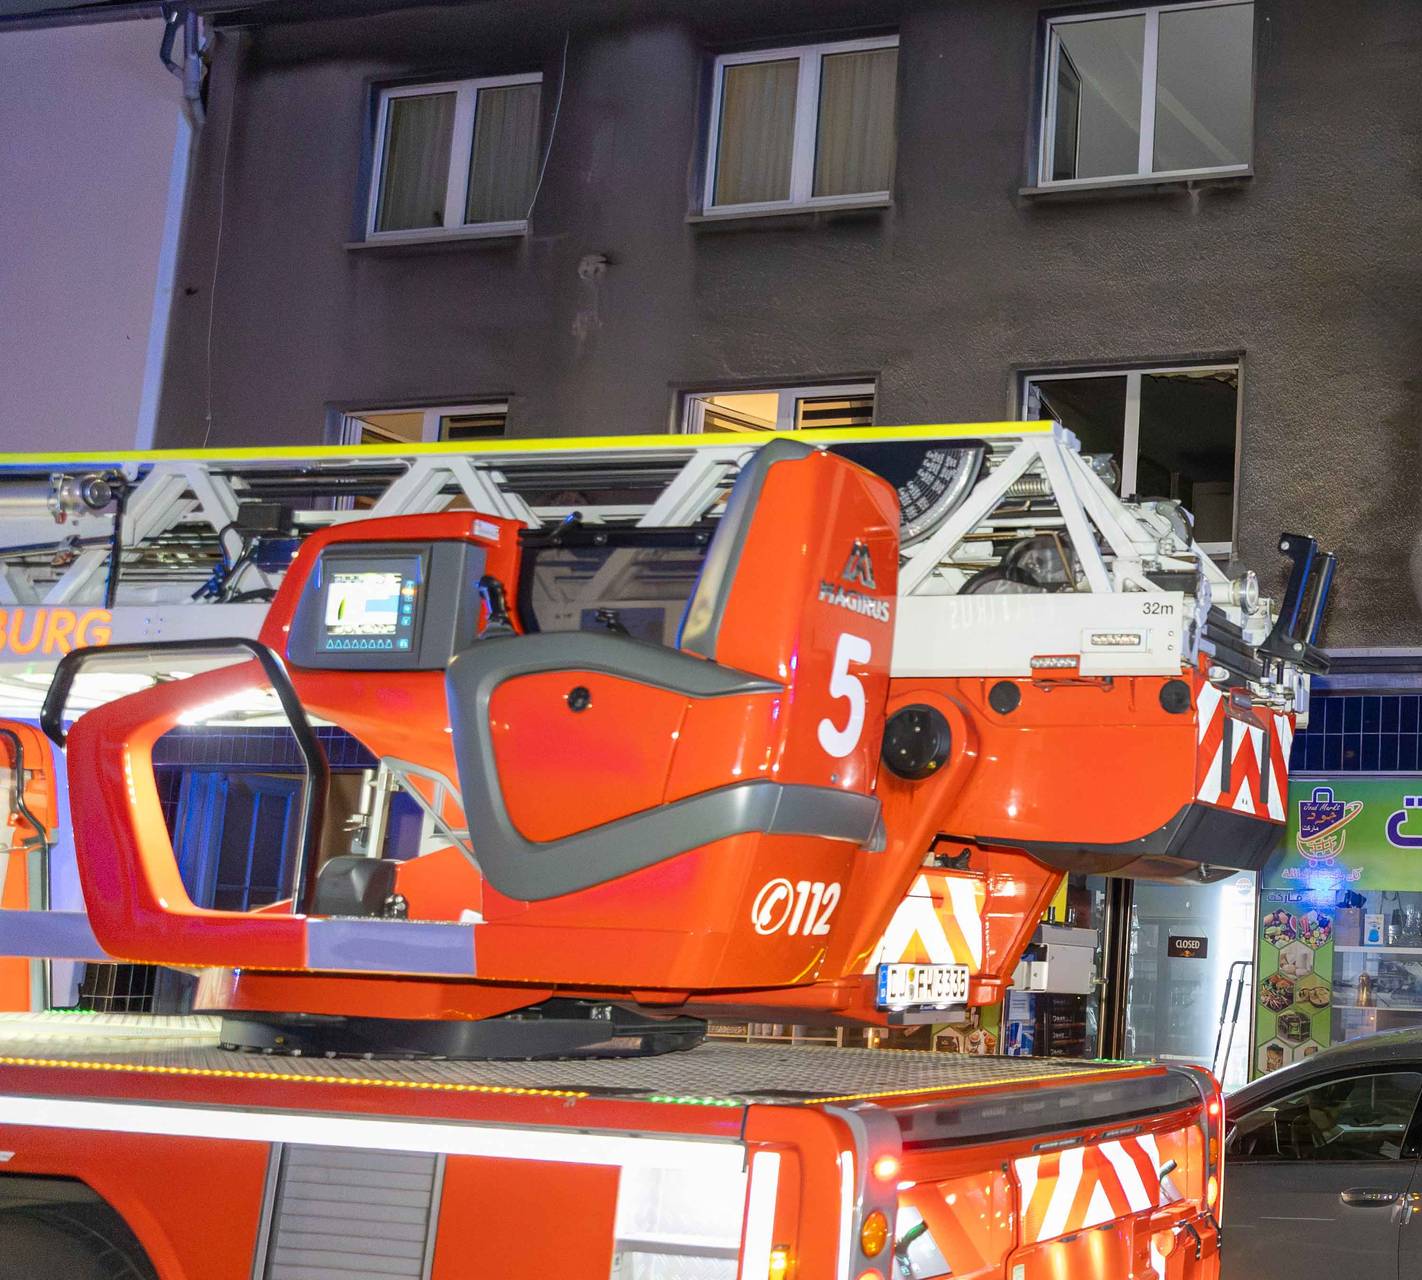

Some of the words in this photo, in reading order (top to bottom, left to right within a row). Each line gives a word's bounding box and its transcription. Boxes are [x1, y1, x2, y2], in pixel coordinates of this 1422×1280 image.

[818, 580, 890, 623] MAGIRUS
[1142, 602, 1174, 616] 32m
[0, 608, 113, 656] URG
[817, 632, 872, 758] 5
[787, 880, 841, 936] 112
[1175, 939, 1200, 949] CLOSED
